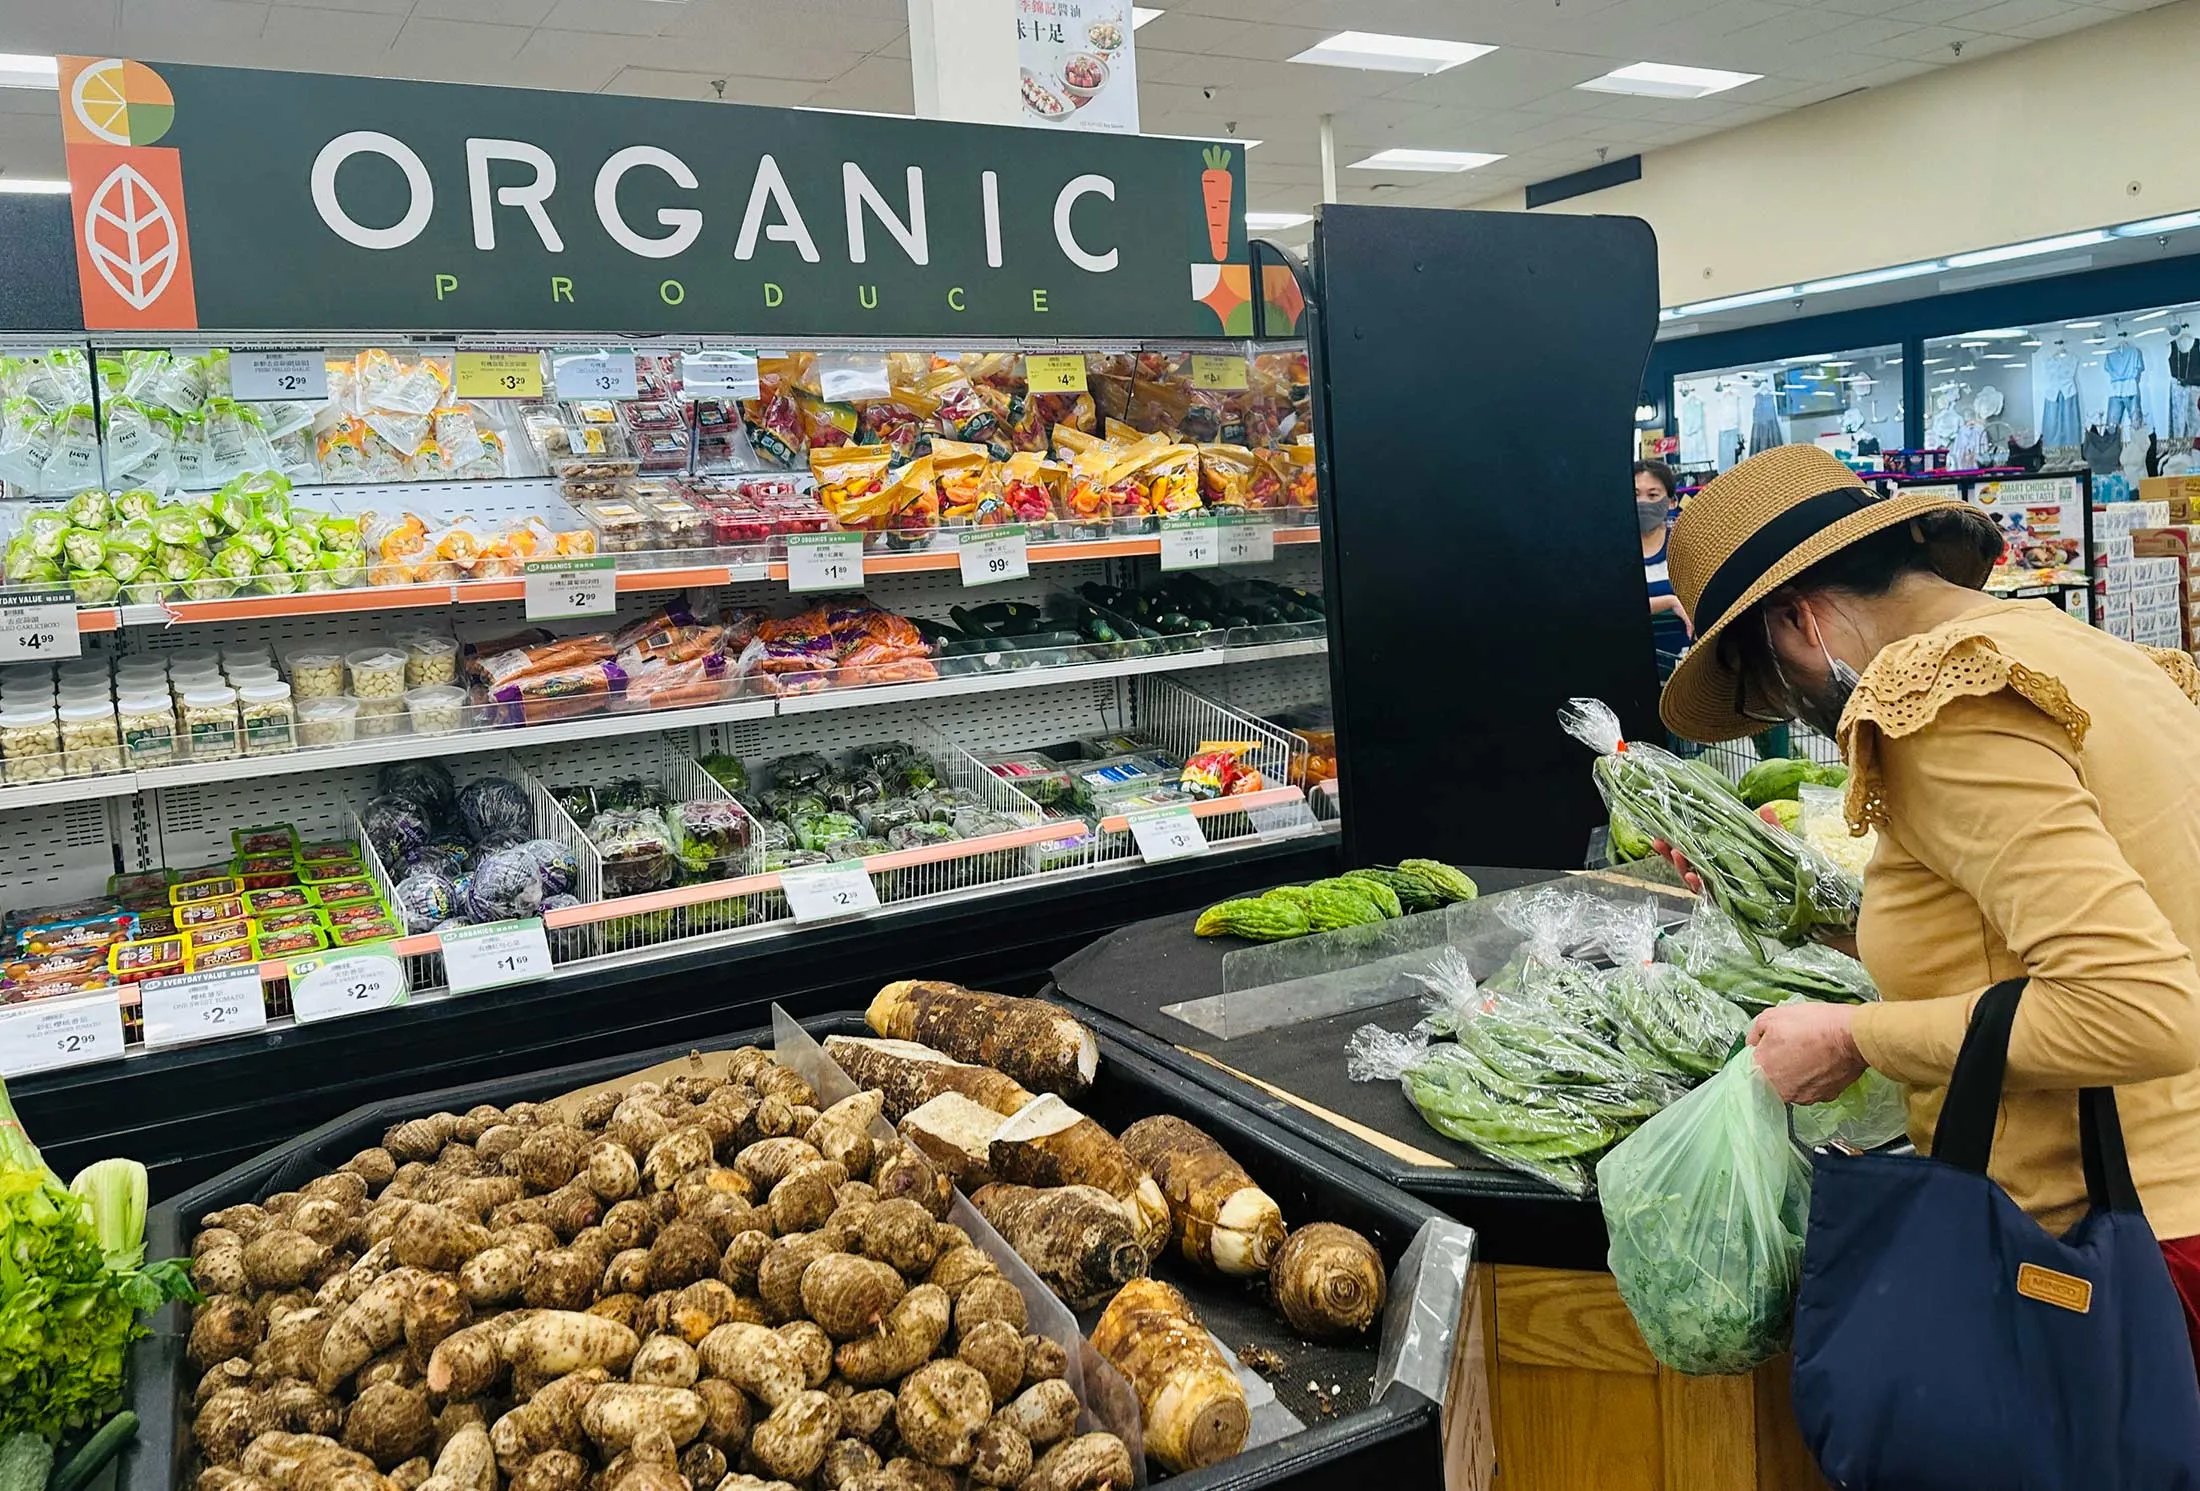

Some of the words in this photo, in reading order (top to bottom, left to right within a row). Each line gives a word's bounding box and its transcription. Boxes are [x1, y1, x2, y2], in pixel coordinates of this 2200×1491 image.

[311, 131, 1118, 272] ORGANIC
[435, 274, 1049, 311] PRODUCE
[2025, 481, 2056, 492] CHOICES
[2000, 492, 2034, 501] AUTHENTIC
[2035, 492, 2055, 501] TASTE
[20, 595, 43, 603] VALUE
[458, 926, 494, 939] ORGANICS
[163, 974, 202, 988] EVERYDAY
[203, 970, 228, 980] VALUE
